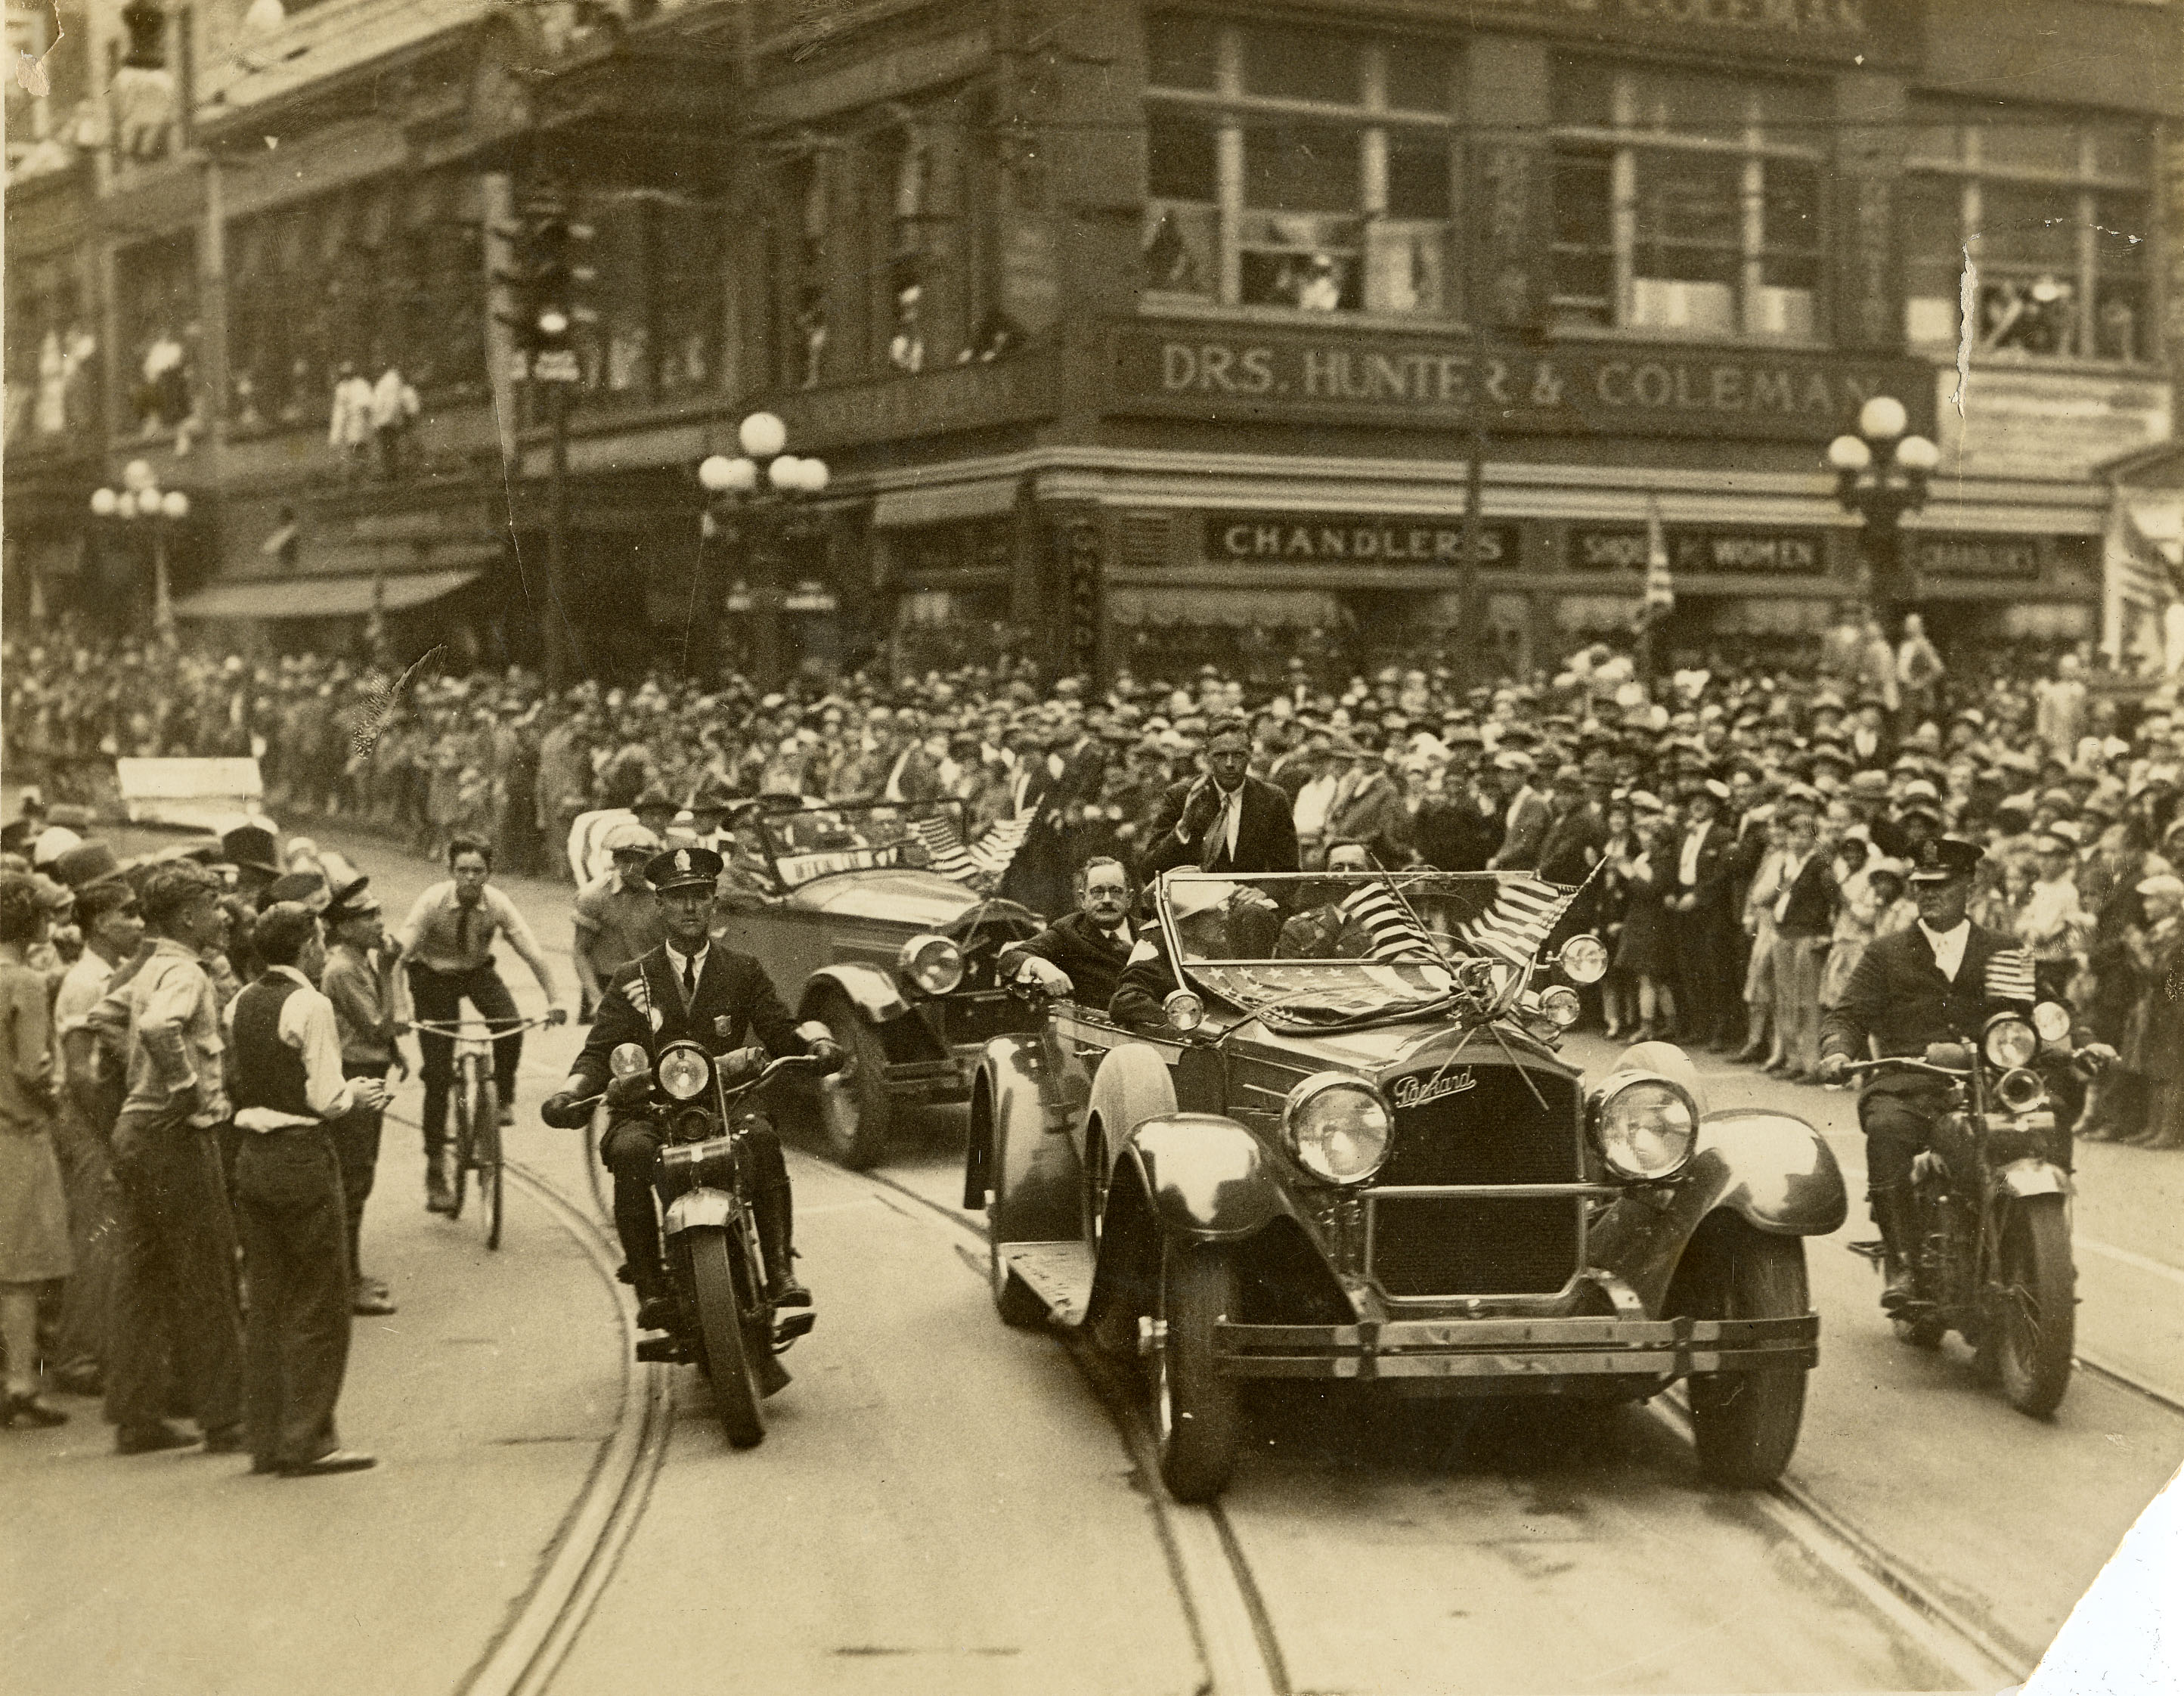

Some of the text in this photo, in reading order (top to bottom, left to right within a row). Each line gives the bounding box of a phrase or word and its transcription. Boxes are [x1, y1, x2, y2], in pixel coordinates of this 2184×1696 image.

[1162, 344, 1881, 414] DRS. HUNTER & COLEMAN
[1713, 539, 1811, 566] WOMEN
[1394, 1065, 1477, 1108] Packard
